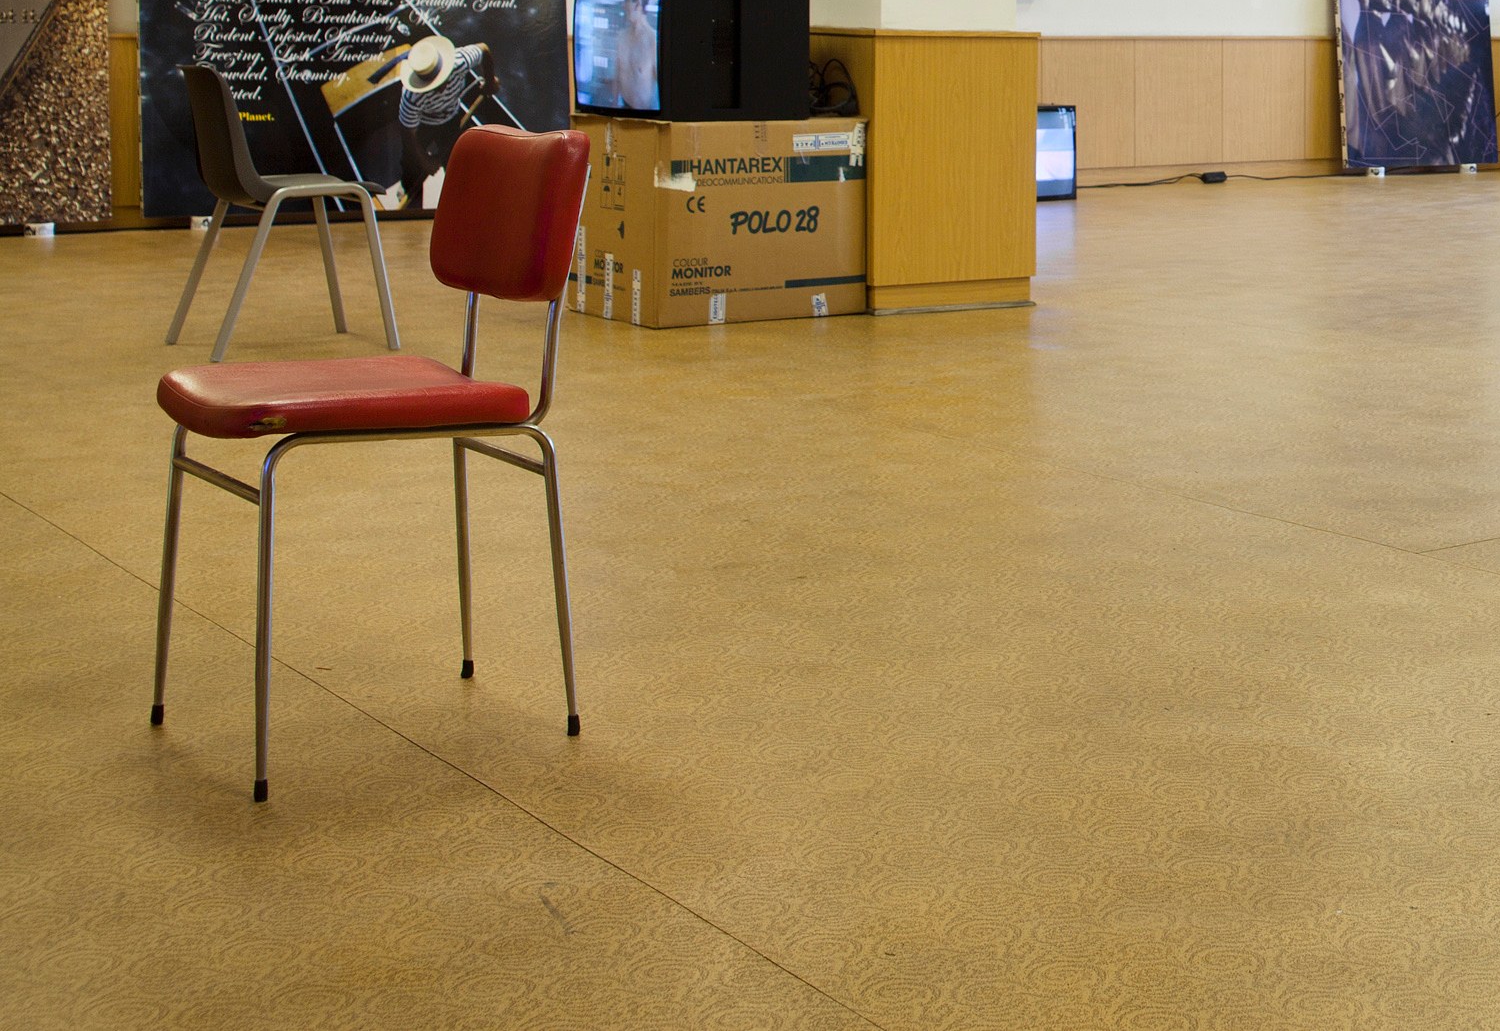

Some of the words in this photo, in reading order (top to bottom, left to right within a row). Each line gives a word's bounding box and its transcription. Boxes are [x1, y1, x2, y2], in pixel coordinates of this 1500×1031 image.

[194, 2, 231, 22] Hot.
[238, 3, 295, 29] Smelly.
[302, 5, 401, 31] Breathtaking.
[194, 23, 256, 42] Rodent
[324, 26, 396, 50] Spinning.
[192, 43, 265, 69] Freezing.
[273, 43, 314, 64] Lush.
[321, 44, 386, 63] Ancient.
[275, 65, 351, 88] Steaming.
[689, 157, 783, 176] HANTAREX
[686, 195, 705, 213] CE
[730, 209, 791, 235] POLO
[795, 205, 820, 233] 28
[671, 265, 731, 280] MONITOR
[673, 258, 708, 268] COLOUR
[669, 286, 710, 297] SAMBERS
